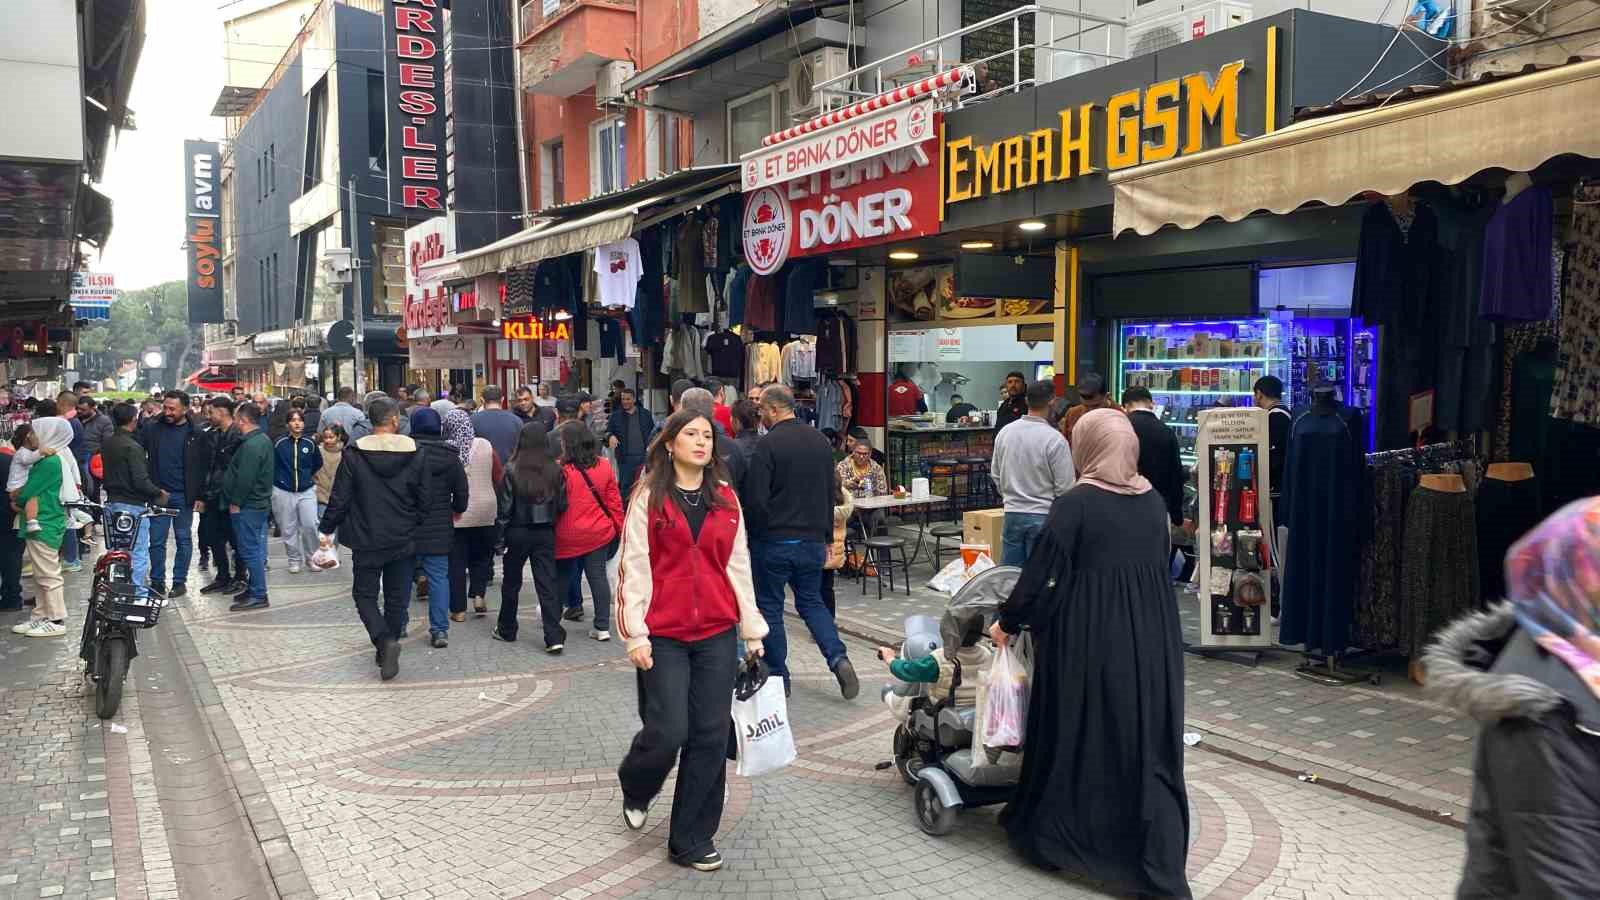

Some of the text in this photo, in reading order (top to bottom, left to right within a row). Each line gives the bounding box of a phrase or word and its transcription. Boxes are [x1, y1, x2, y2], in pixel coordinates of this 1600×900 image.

[765, 116, 898, 180] ET BANK DÖNER
[946, 59, 1246, 203] EMRAH GSM
[189, 153, 222, 289] soylu avm
[799, 187, 913, 250] DÖNER
